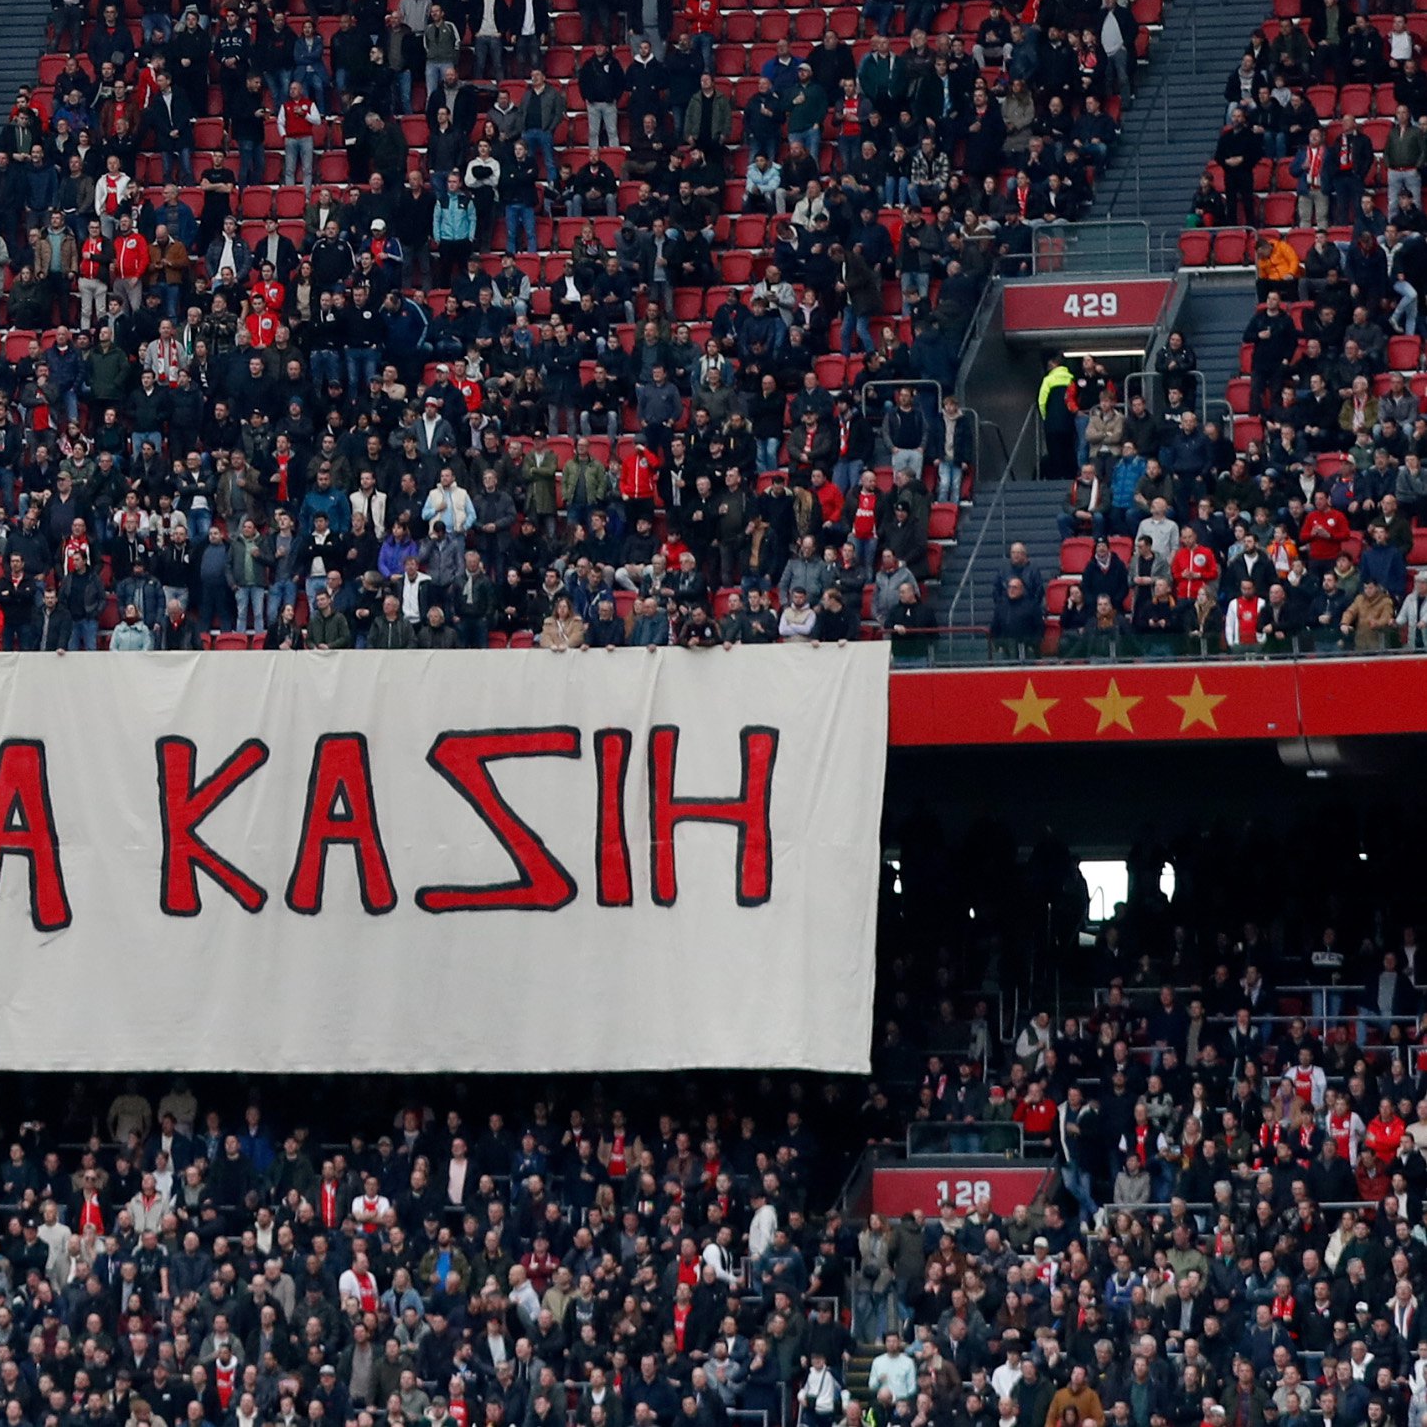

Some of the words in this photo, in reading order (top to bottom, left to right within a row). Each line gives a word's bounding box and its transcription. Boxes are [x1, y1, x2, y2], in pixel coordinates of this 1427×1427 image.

[1063, 292, 1118, 318] 429
[155, 724, 780, 916] KASIH
[936, 1180, 991, 1207] 128
